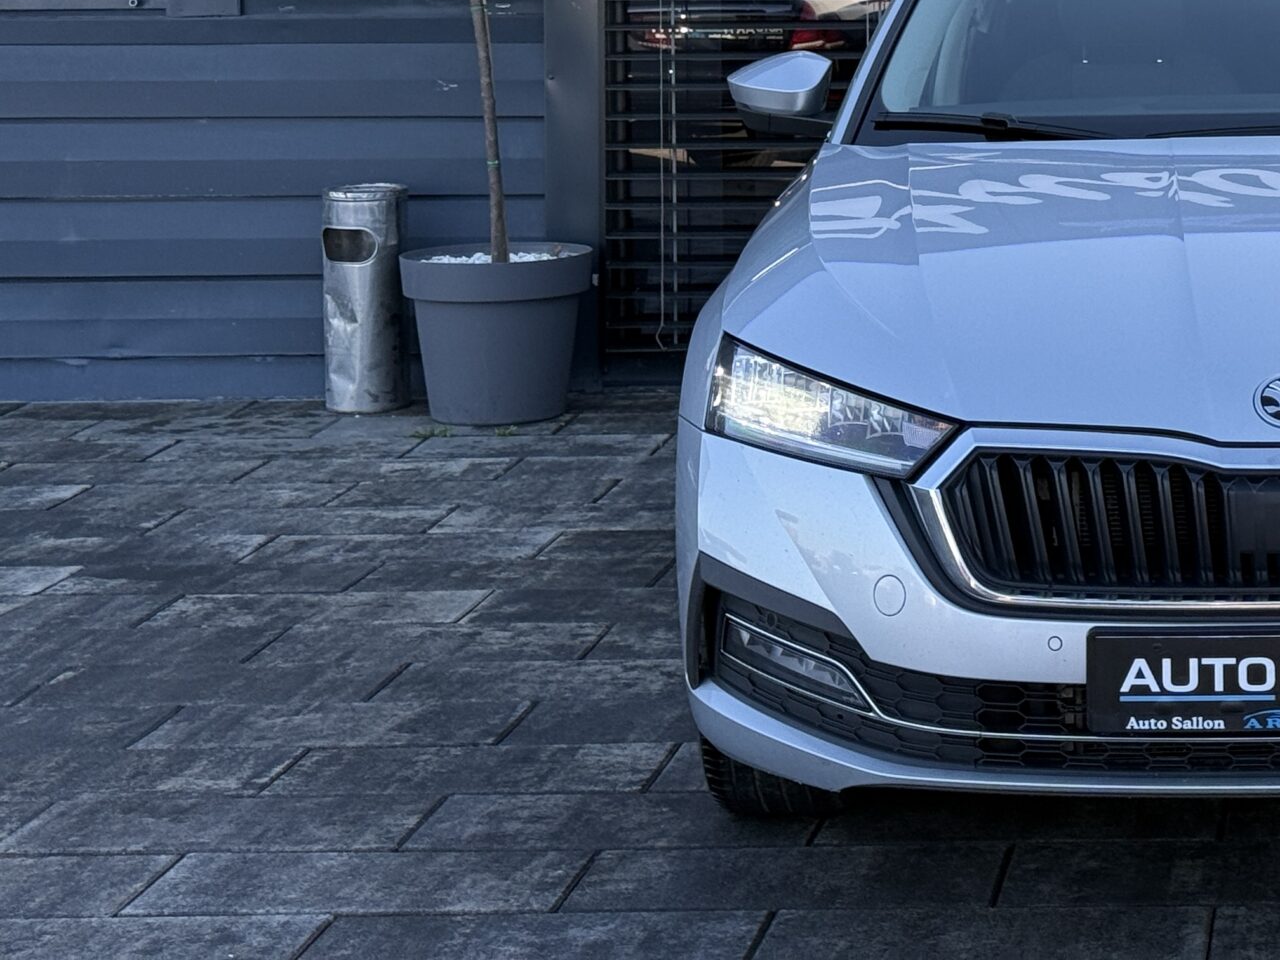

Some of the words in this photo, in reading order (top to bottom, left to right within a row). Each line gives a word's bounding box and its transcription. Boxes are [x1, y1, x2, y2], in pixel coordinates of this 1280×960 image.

[1120, 657, 1276, 693] AUTO
[1126, 716, 1169, 730] Auto
[1172, 716, 1225, 730] Sallon
